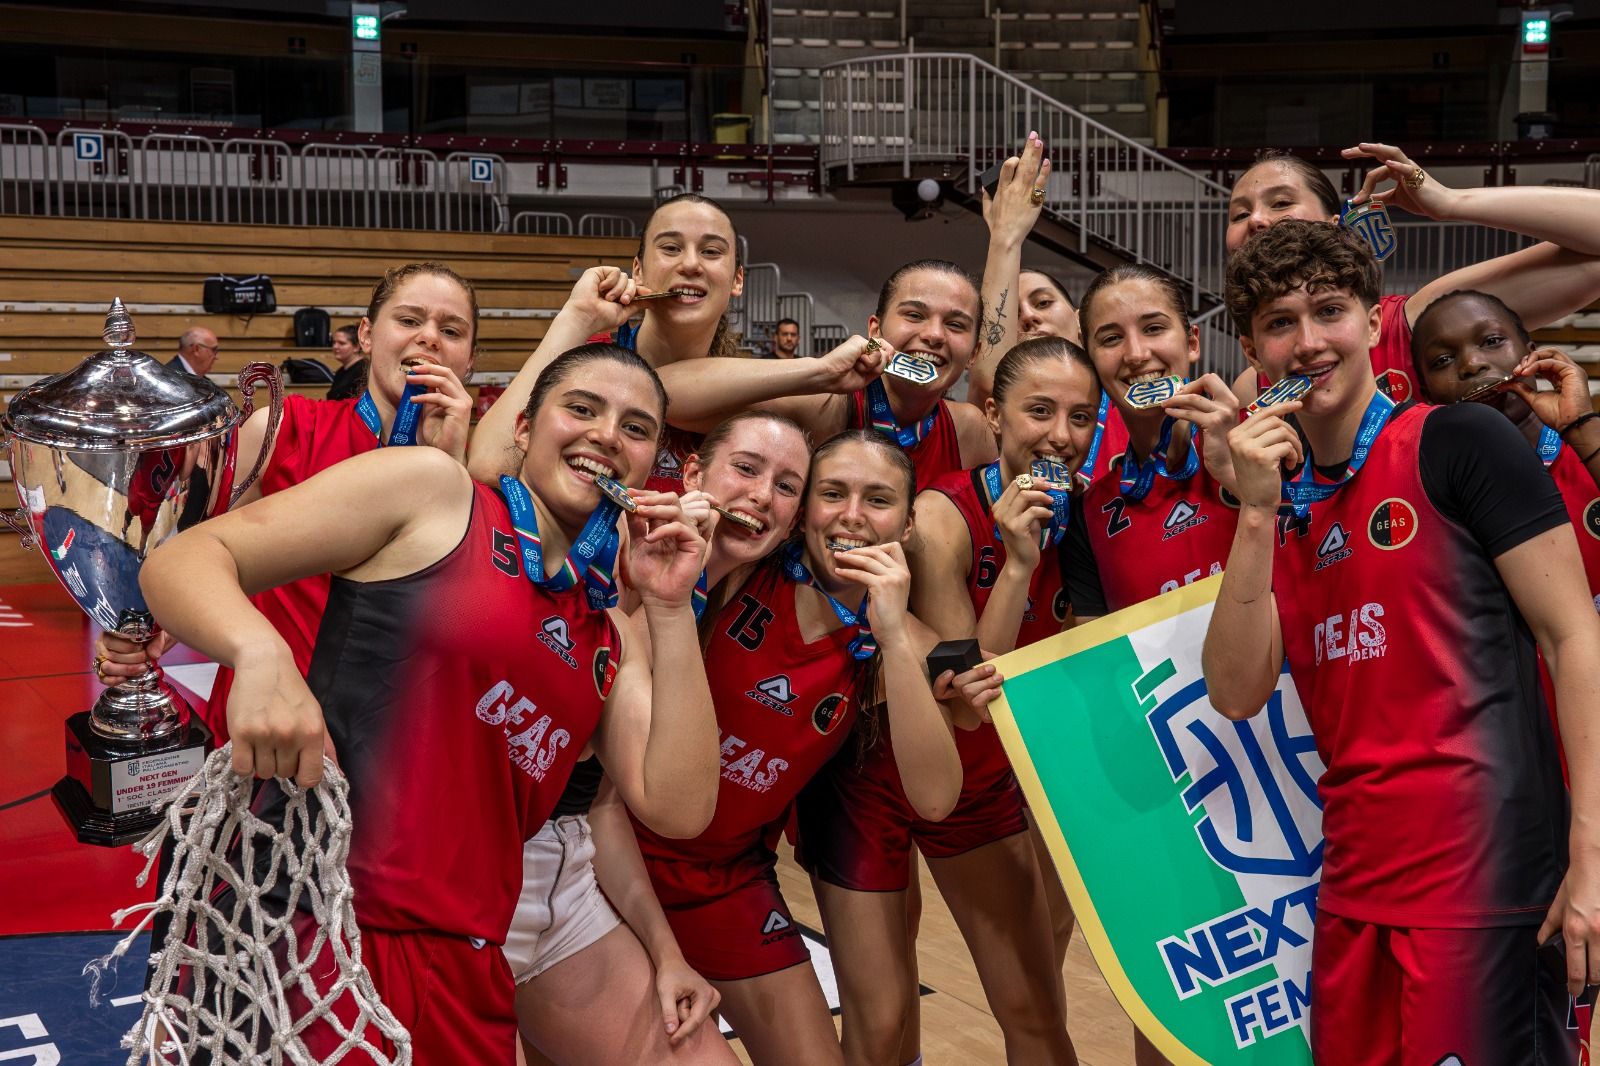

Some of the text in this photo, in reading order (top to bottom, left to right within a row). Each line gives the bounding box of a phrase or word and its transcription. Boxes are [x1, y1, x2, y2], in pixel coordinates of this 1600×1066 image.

[81, 138, 98, 157] D
[475, 161, 489, 179] D
[1381, 383, 1403, 394] EAS
[1102, 496, 1132, 538] 2
[1376, 517, 1406, 531] GEAS
[492, 526, 520, 577] 5
[977, 545, 996, 588] 6
[1349, 644, 1388, 667] DEMY
[475, 680, 571, 771] GEAS
[821, 707, 840, 721] GEA
[718, 728, 789, 786] EAS
[116, 774, 194, 796] UNDER 19 FEMMIN
[139, 769, 178, 783] NEXT GEN
[720, 770, 771, 794] ACADEMY
[1231, 971, 1311, 1043] FEM
